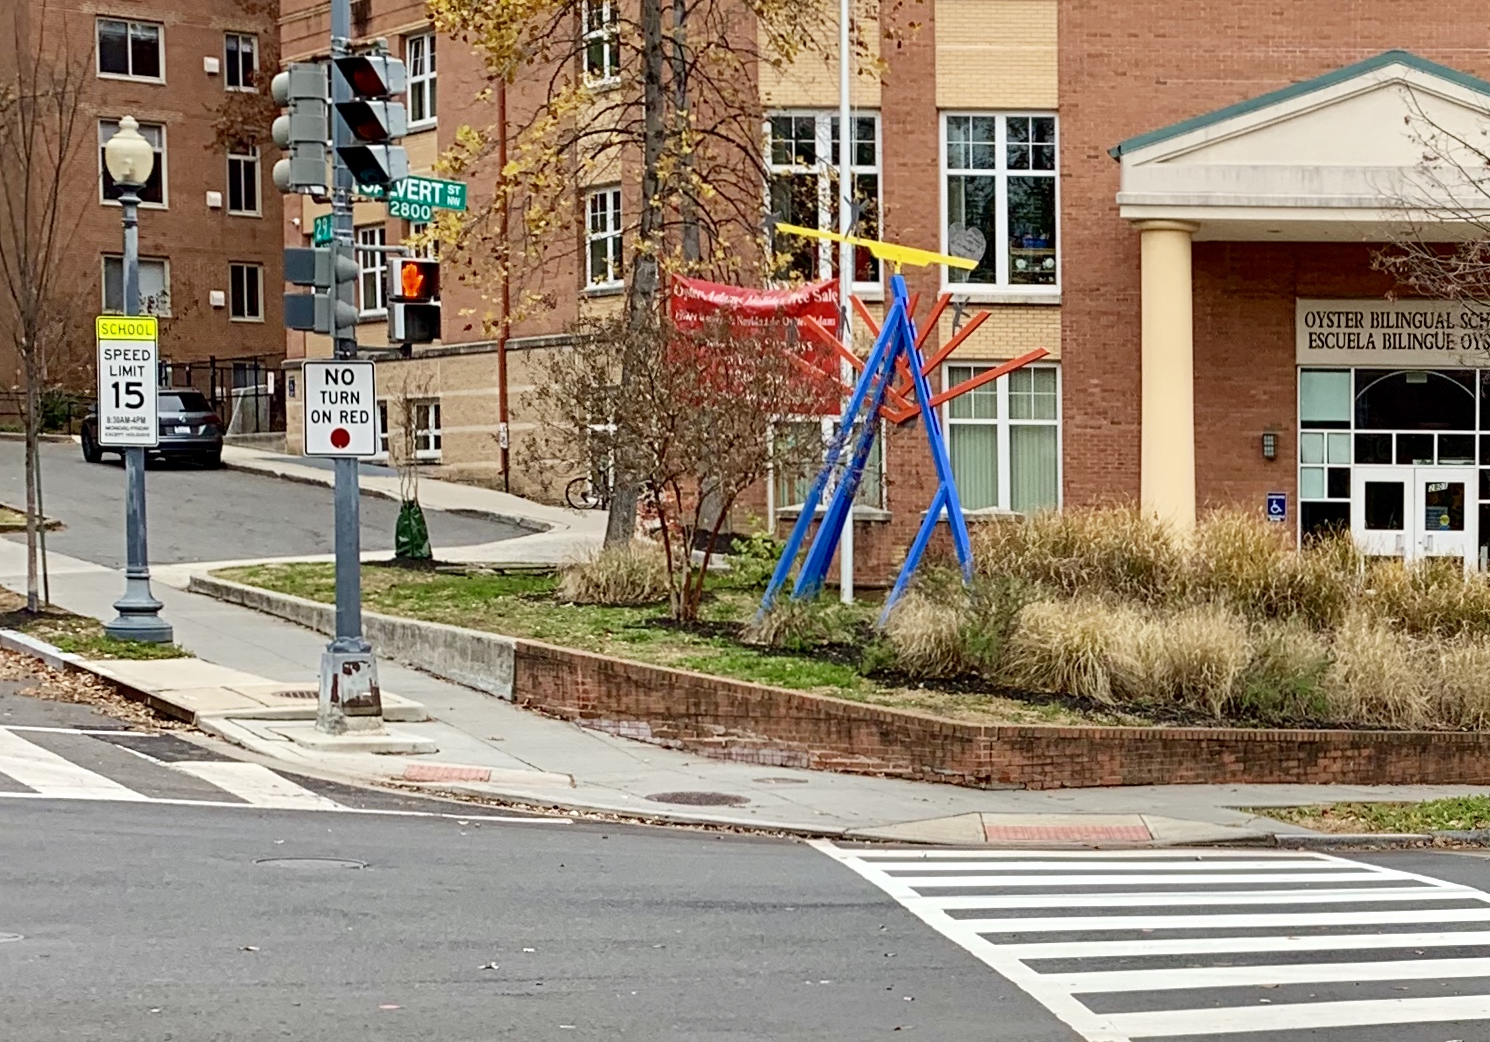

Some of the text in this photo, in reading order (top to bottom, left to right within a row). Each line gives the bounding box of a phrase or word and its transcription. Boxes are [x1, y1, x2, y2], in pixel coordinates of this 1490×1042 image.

[361, 178, 461, 204] VERT ST
[446, 195, 461, 207] NW
[390, 201, 431, 220] 2800
[812, 287, 839, 303] Sale
[1304, 311, 1364, 329] OYSTER
[1370, 311, 1455, 329] BILINGUAL
[101, 323, 153, 336] SCHOOL
[1308, 332, 1376, 350] ESCUELA
[104, 348, 151, 361] SPEED
[109, 365, 145, 377] LIMIT
[325, 368, 355, 386] NO
[111, 381, 145, 409] 15
[320, 390, 360, 405] TURN
[311, 409, 369, 424] ON RED
